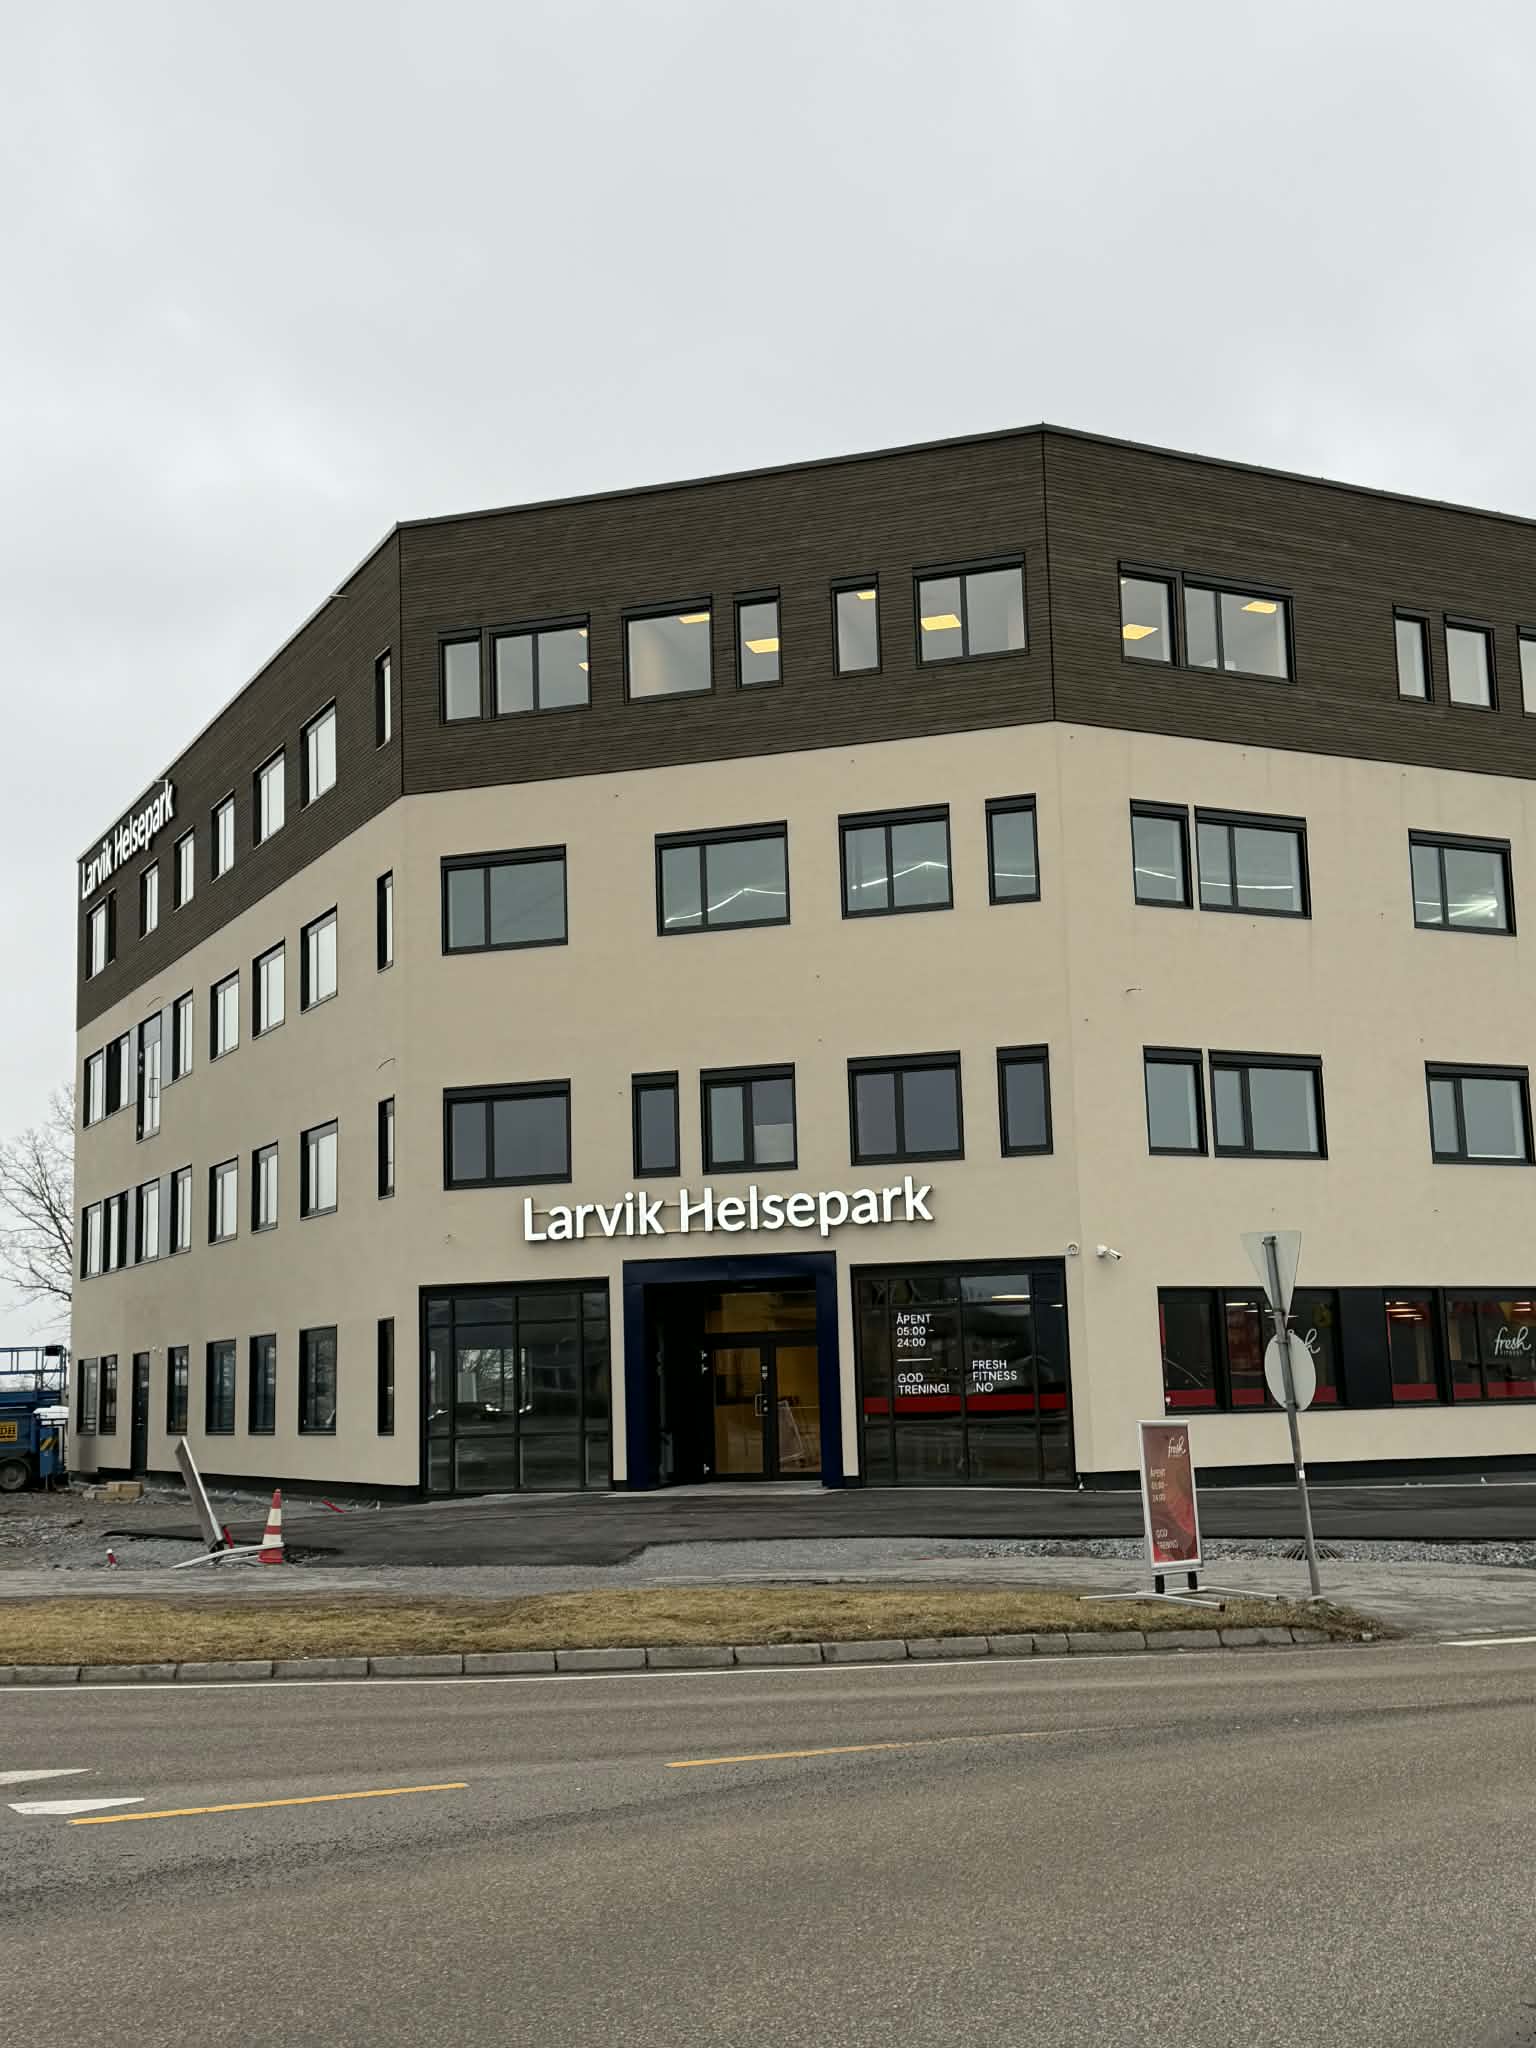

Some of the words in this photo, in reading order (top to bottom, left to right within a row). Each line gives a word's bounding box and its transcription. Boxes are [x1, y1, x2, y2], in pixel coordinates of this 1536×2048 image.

[82, 839, 112, 900] Larvik
[114, 779, 174, 870] Helsepark
[523, 1191, 665, 1242] Larvik
[679, 1175, 934, 1237] Helsepark
[896, 1312, 931, 1325] ÅPENT
[896, 1326, 926, 1336] 05:00
[896, 1337, 926, 1348] 24:00
[1494, 1326, 1532, 1356] fresh
[972, 1360, 1007, 1370] FRESH
[897, 1373, 924, 1384] GOD
[972, 1370, 1018, 1382] FITNESS
[897, 1383, 950, 1395] TRENING!
[1167, 1435, 1186, 1458] fresh
